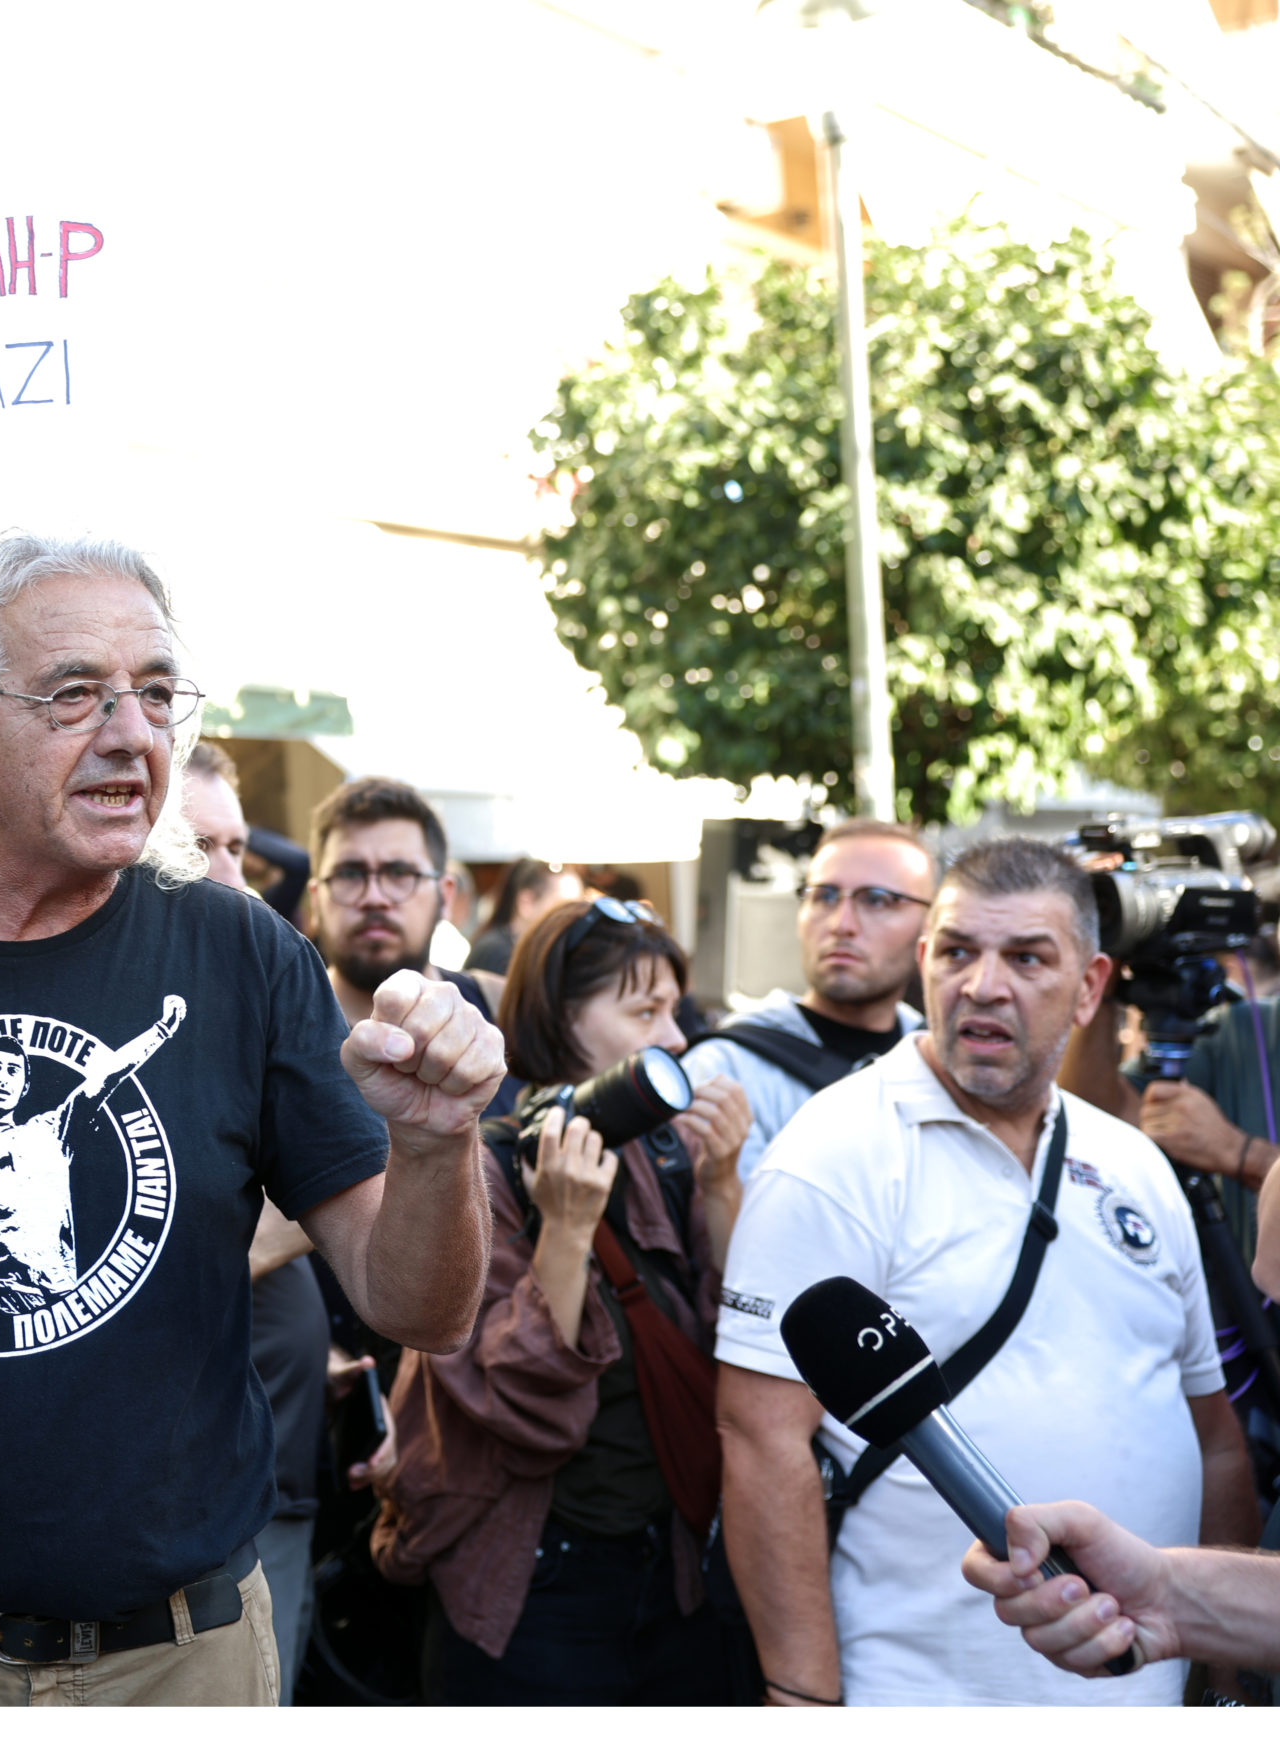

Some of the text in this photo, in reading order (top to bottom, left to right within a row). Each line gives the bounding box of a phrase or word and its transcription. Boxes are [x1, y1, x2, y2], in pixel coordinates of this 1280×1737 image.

[29, 1020, 97, 1068] ΠΟΤΕ
[13, 1227, 156, 1349] ΠΟΛΕΜΑΜΕ
[121, 1107, 168, 1220] ΠΑΝΤΑ!
